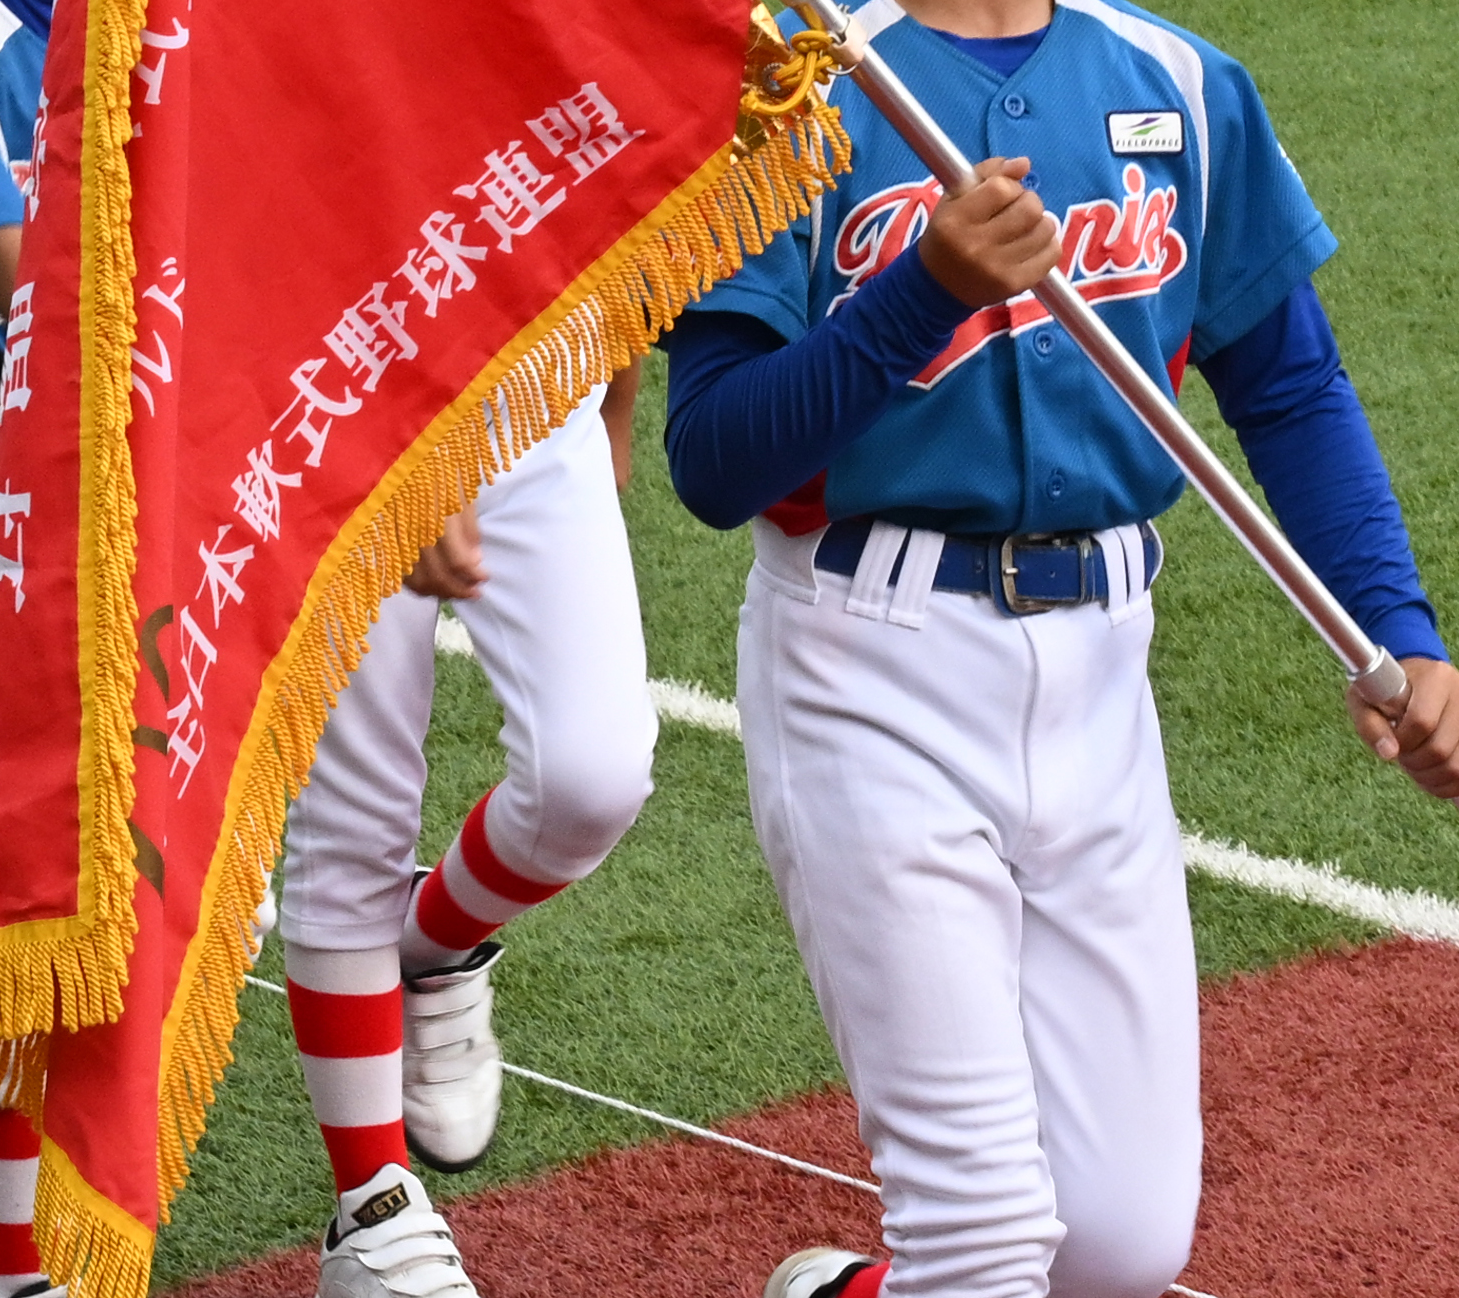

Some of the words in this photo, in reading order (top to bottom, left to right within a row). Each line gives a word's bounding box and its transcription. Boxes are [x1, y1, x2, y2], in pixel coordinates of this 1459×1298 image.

[1115, 138, 1179, 147] FIELDFORCE
[833, 163, 1181, 311] Pnix
[167, 81, 646, 800] 全日本軟式野球連盟
[359, 1186, 404, 1221] ZETT
